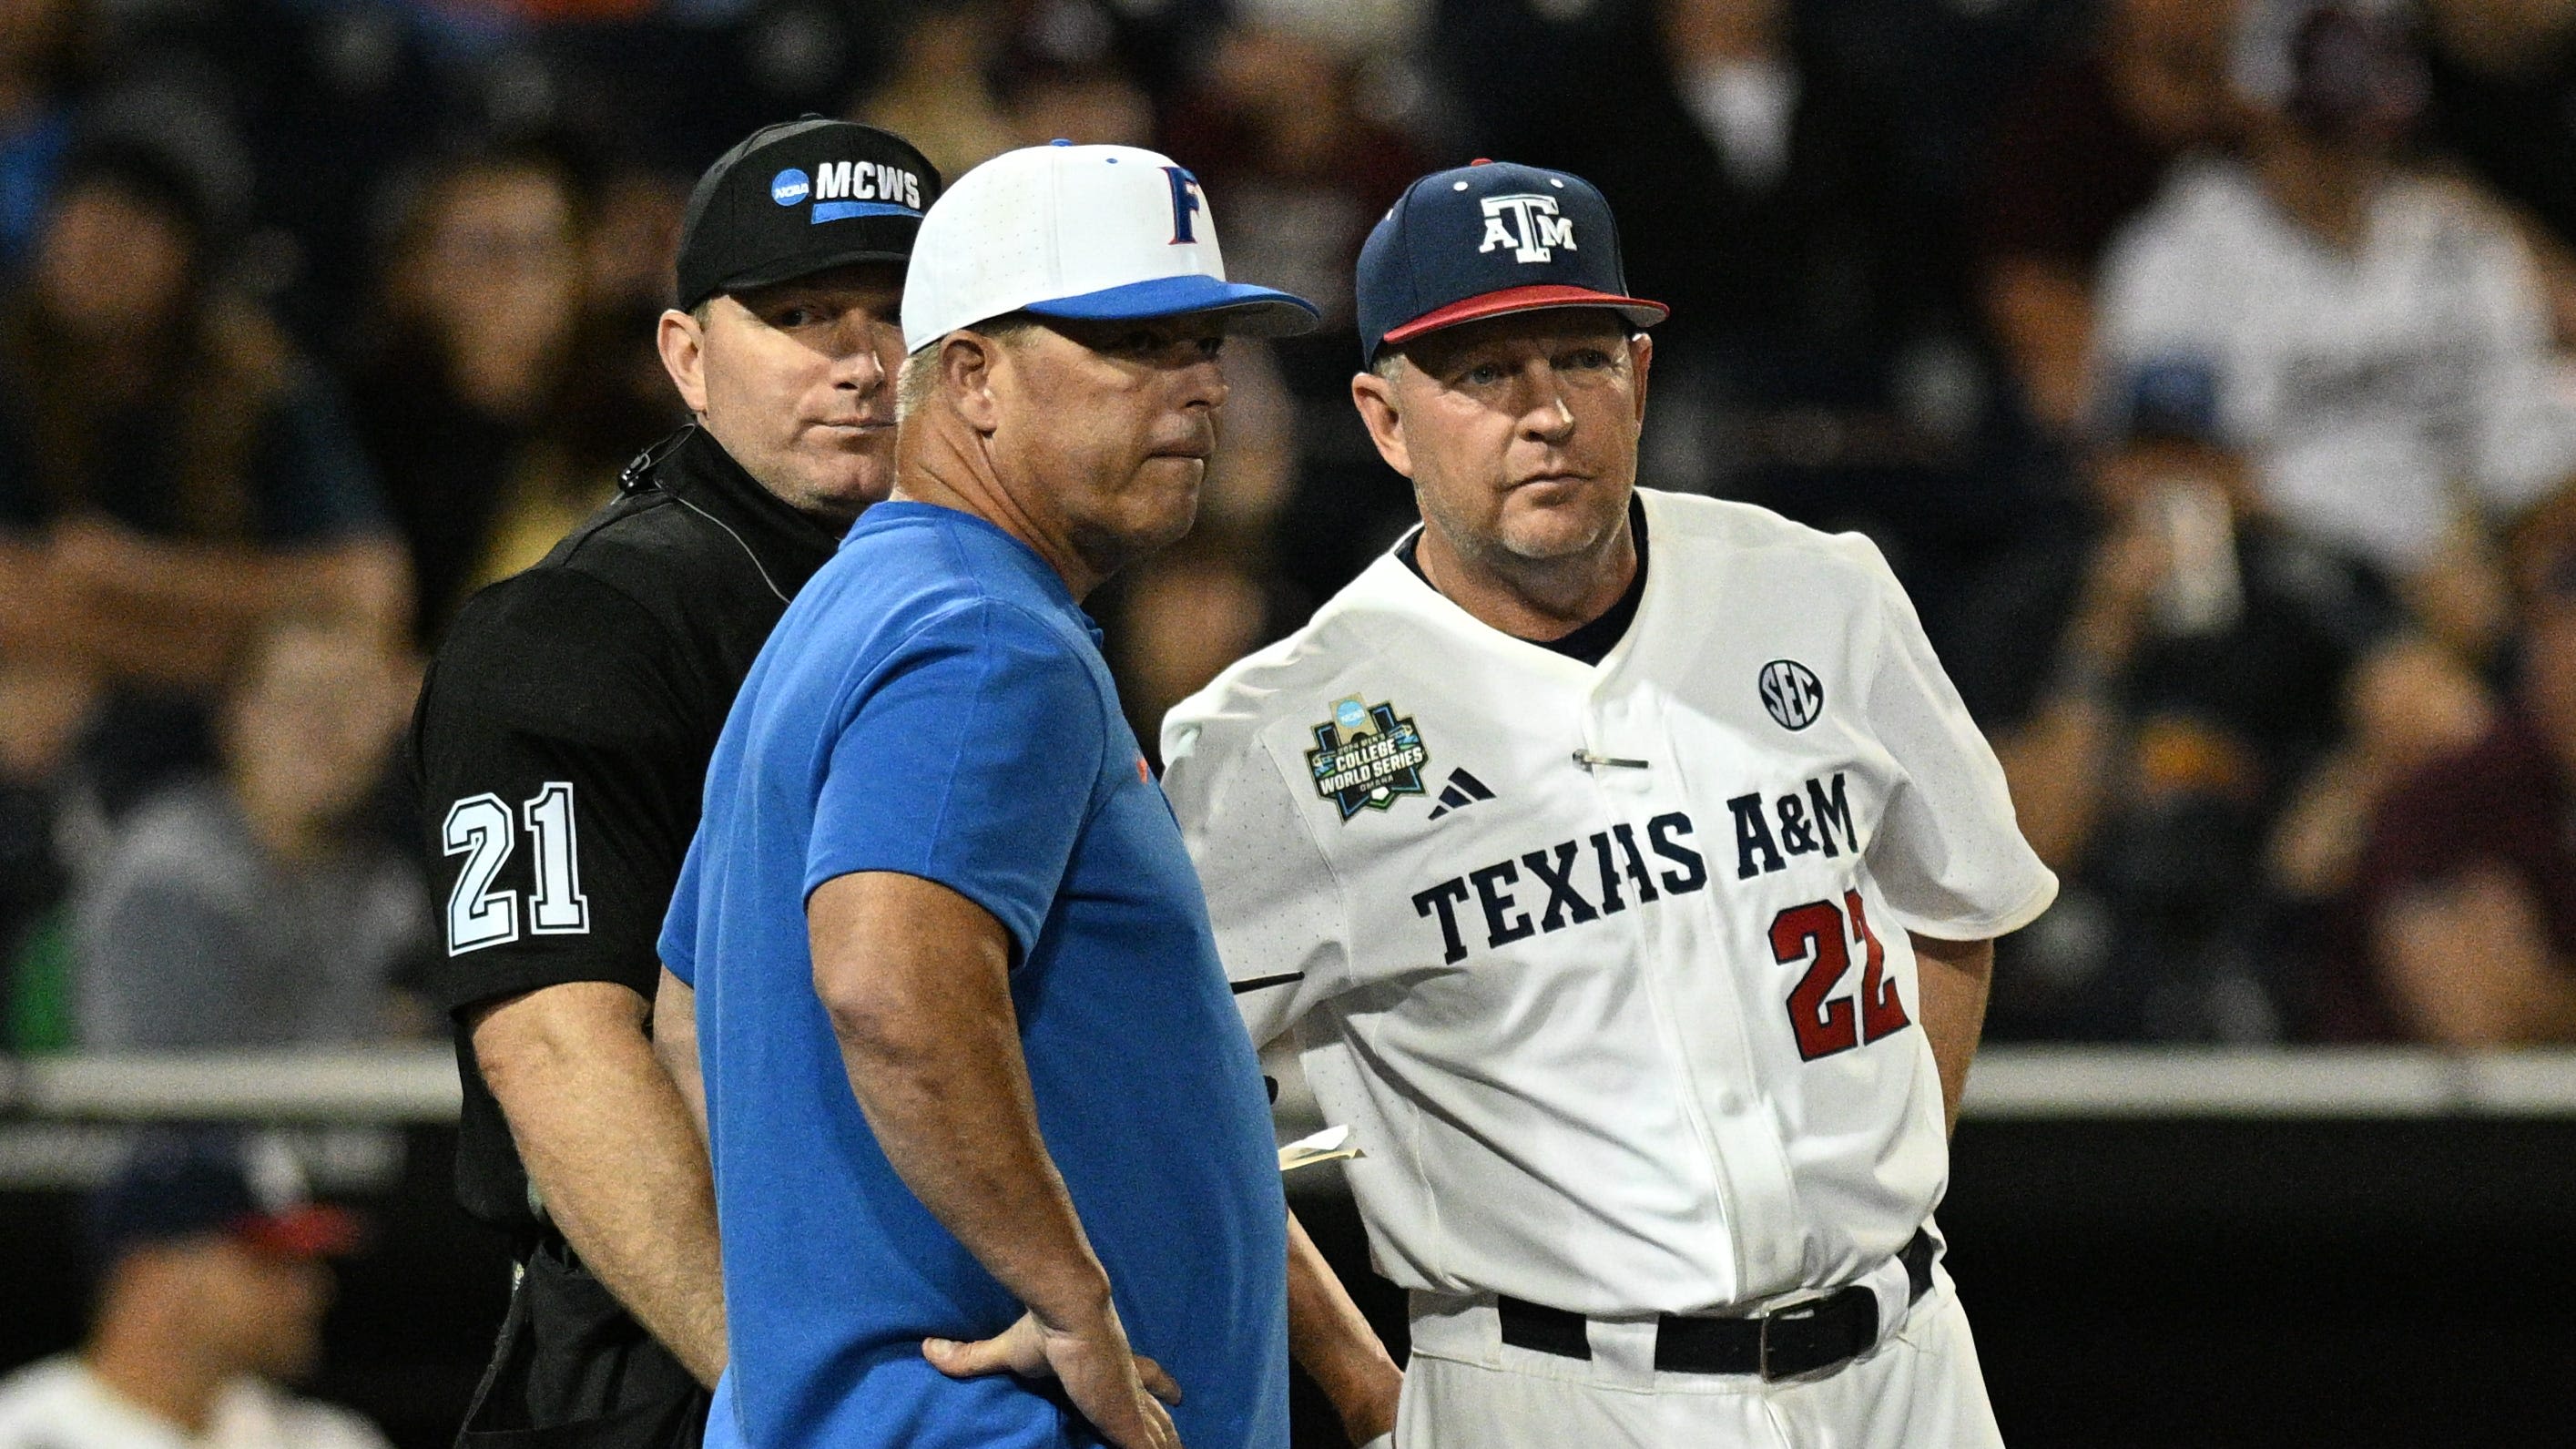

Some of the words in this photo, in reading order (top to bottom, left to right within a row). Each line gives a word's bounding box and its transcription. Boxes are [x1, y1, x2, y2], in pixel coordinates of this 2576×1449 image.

[816, 160, 921, 209] MCWS
[1157, 167, 1200, 245] F
[1761, 662, 1819, 728] SEC
[1319, 764, 1371, 795] WORLD
[1371, 746, 1423, 778] SERIES
[1335, 738, 1397, 772] COLLEGE
[443, 781, 590, 957] 21
[1411, 811, 1708, 965] TEXAS
[1726, 772, 1859, 881] A&M
[1767, 888, 1911, 1063] 22
